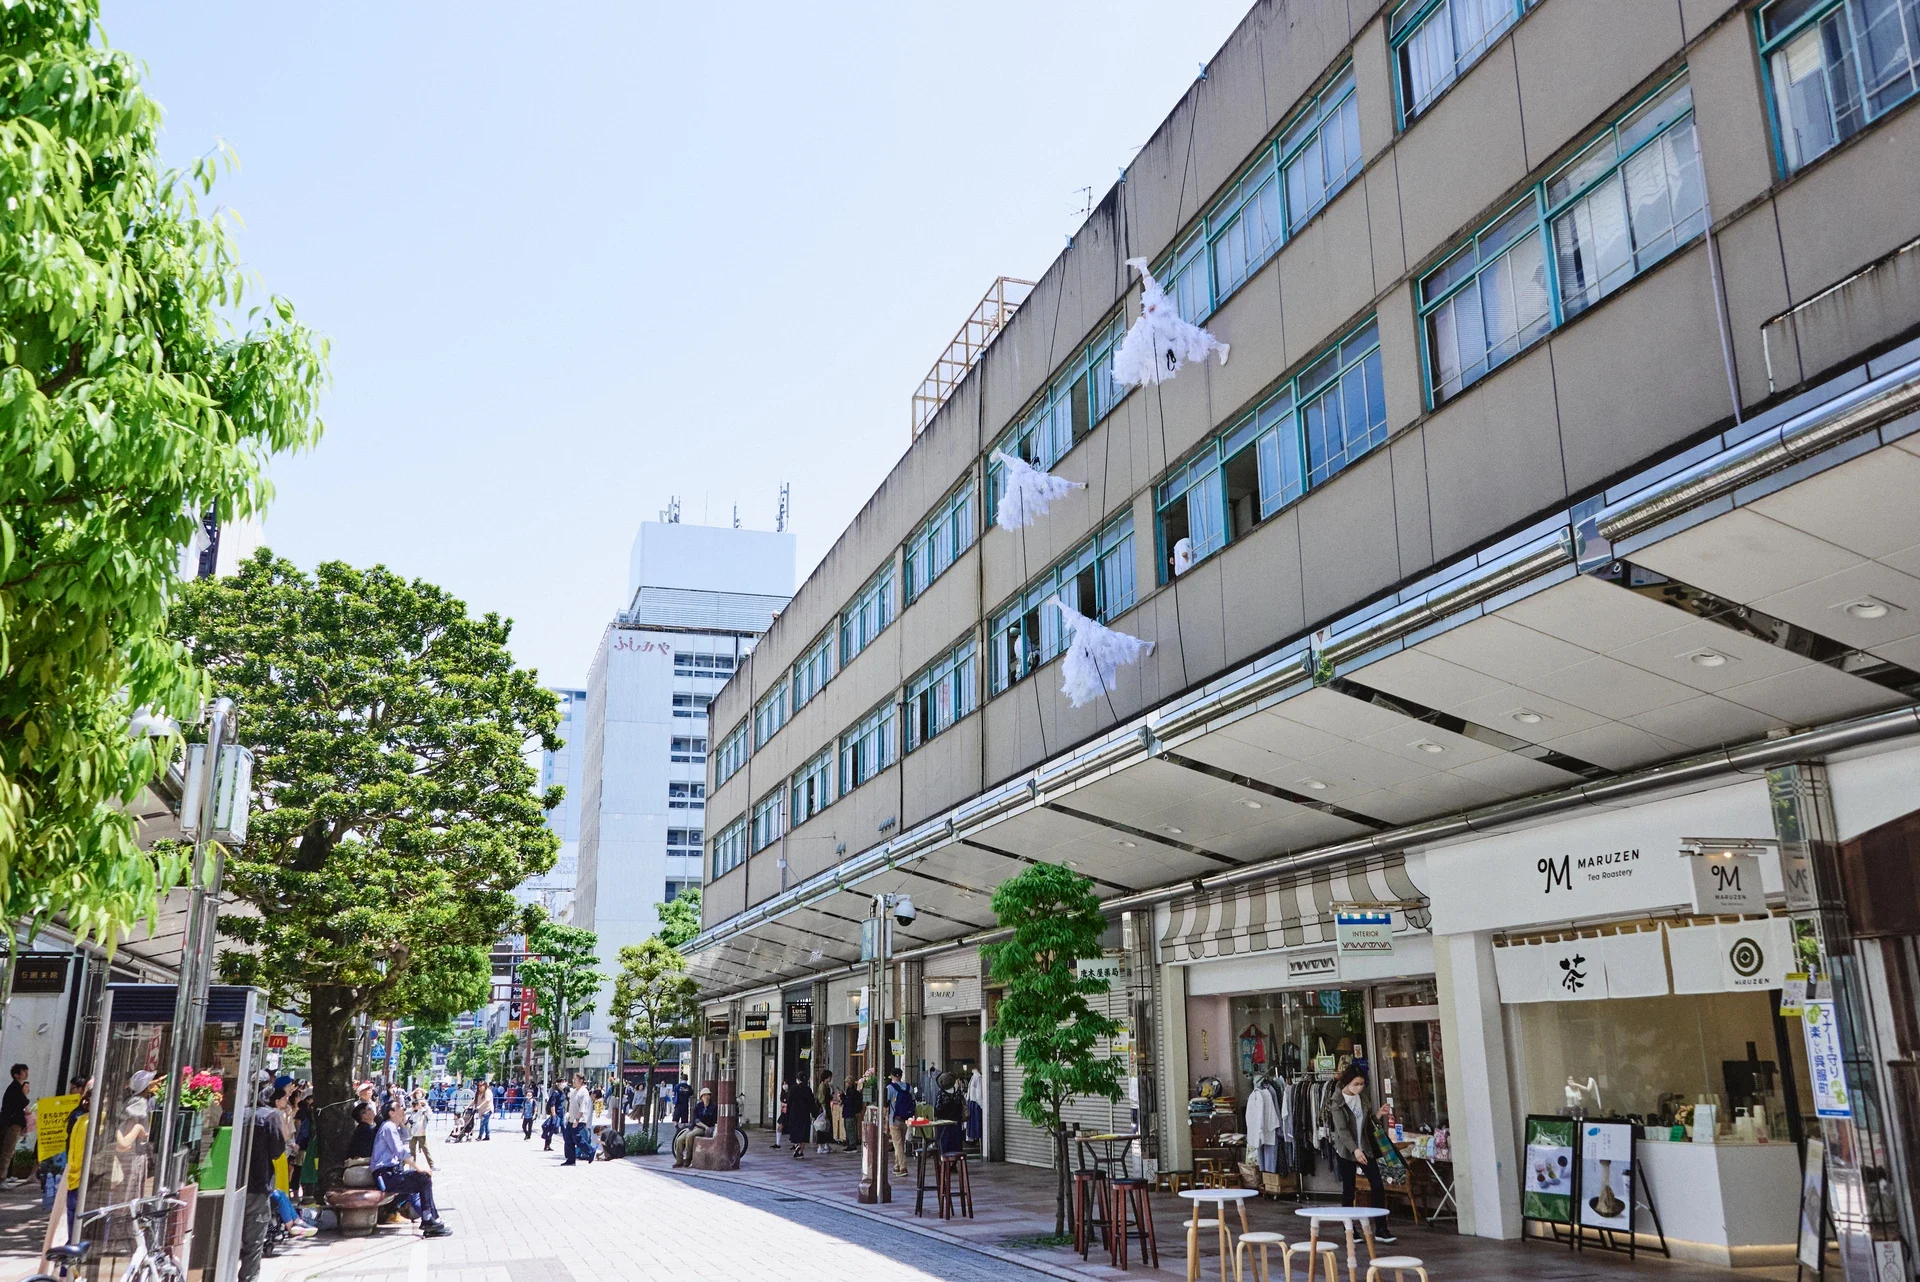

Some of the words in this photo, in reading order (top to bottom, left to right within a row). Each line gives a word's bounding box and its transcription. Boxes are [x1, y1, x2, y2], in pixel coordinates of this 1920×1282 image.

[613, 636, 670, 655] ふしみや
[1577, 848, 1640, 869] MARUZEN
[1587, 873, 1600, 881] Tea
[1601, 868, 1633, 880] Roastery
[1559, 953, 1588, 993] 茶
[1734, 978, 1770, 986] MARUZEN
